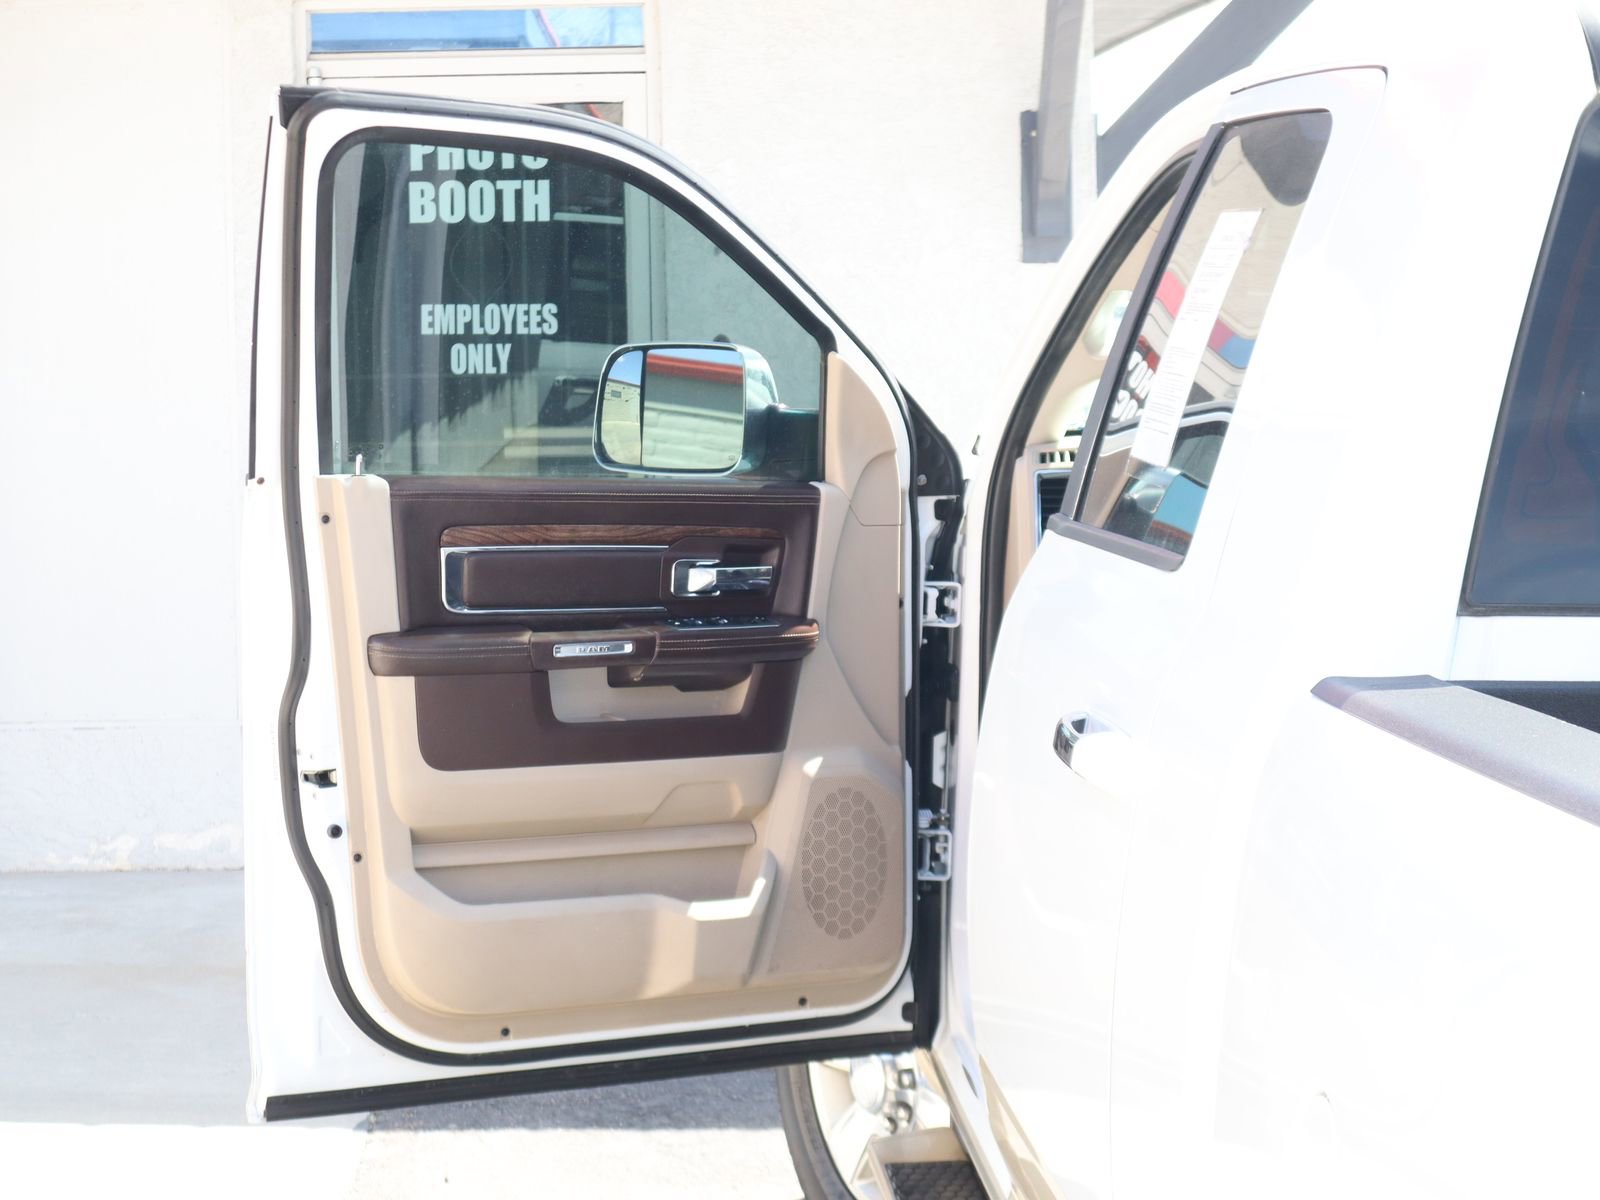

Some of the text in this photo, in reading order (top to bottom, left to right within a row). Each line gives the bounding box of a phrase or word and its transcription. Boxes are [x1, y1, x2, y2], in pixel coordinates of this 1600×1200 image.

[408, 179, 551, 224] BOOTH
[420, 303, 559, 336] EMPLOYEES
[450, 342, 512, 375] ONLY
